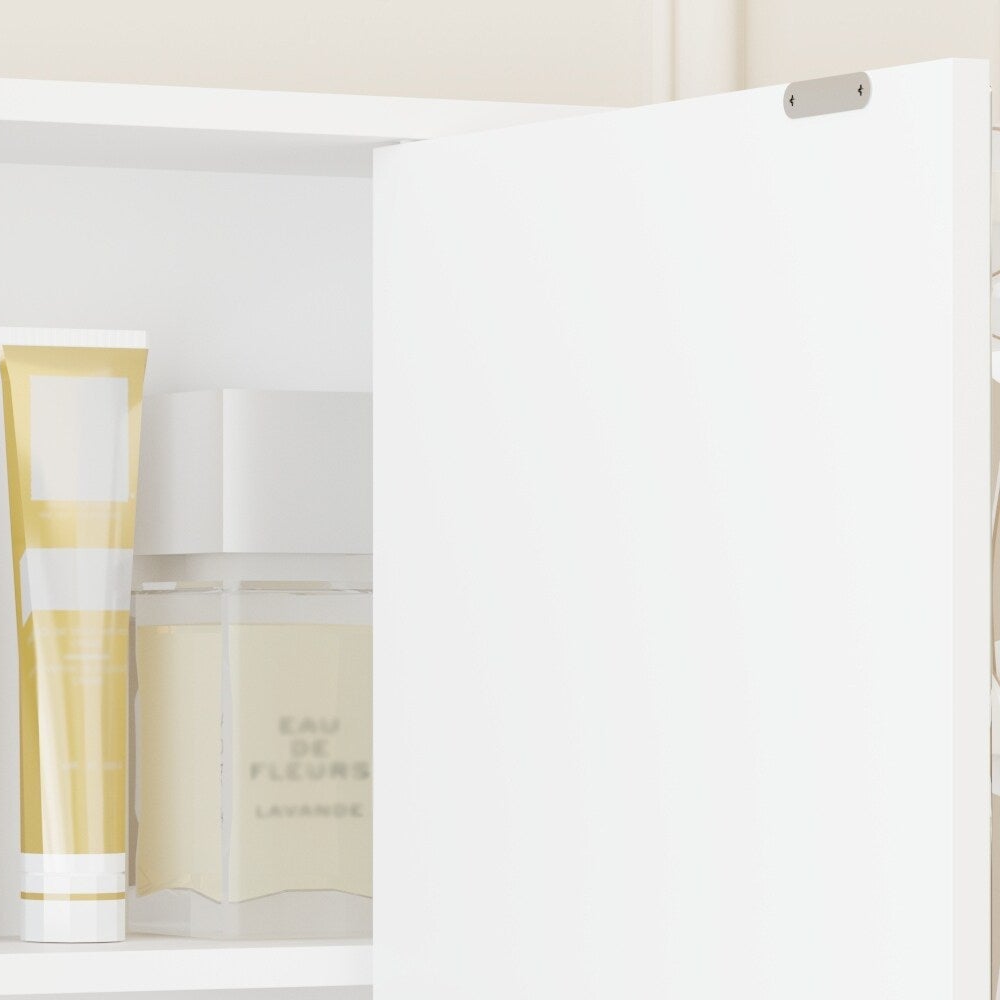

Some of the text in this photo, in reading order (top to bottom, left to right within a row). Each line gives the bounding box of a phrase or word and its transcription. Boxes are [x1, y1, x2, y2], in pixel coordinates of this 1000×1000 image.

[279, 716, 341, 736] EAU
[290, 739, 330, 759] DE
[249, 761, 371, 781] FLEURS
[254, 803, 364, 819] LAVANDE
